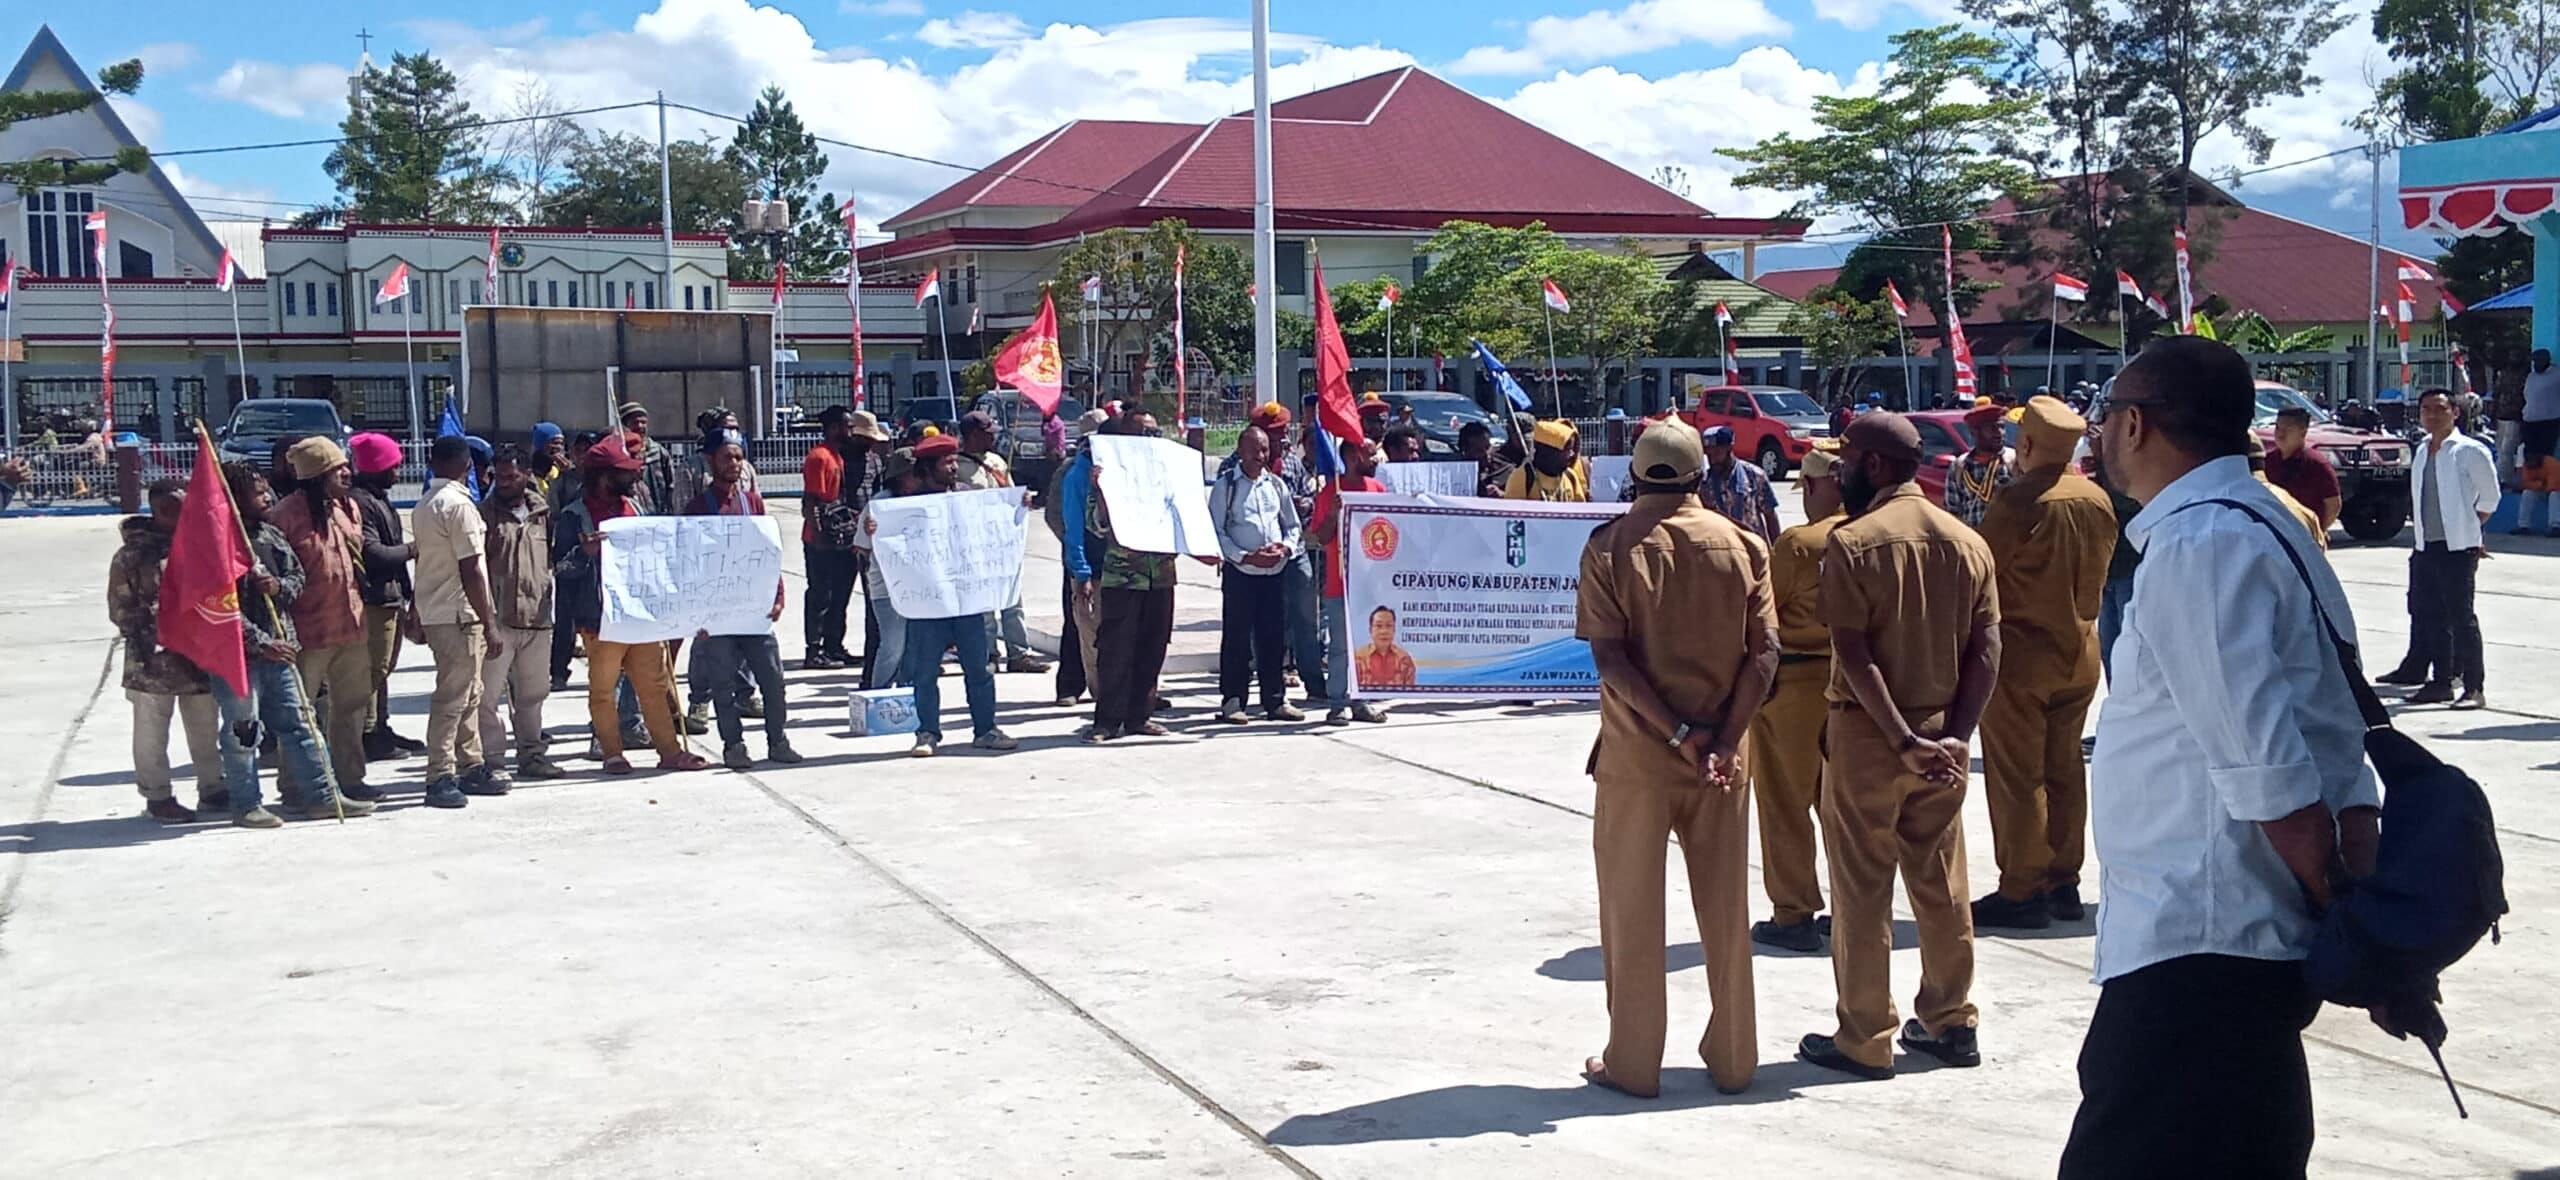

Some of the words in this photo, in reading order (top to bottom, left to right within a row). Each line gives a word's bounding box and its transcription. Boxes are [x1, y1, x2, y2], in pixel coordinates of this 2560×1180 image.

[1392, 574, 1467, 588] CIPAYUNG
[1472, 575, 1558, 589] KABUPATEN
[1402, 601, 1419, 612] KAMI
[1452, 602, 1476, 613] DENGAN
[1477, 602, 1496, 613] TEGAS
[1497, 603, 1519, 613] KEPADA
[1521, 603, 1540, 614] BAPAK
[1463, 618, 1475, 628] DAN
[1505, 618, 1531, 629] KEMBALI
[1532, 619, 1557, 629] MENJADI
[1401, 632, 1440, 643] LINGKUNGAN
[1442, 633, 1470, 643] PROVINSI
[1471, 633, 1490, 644] PAPUA
